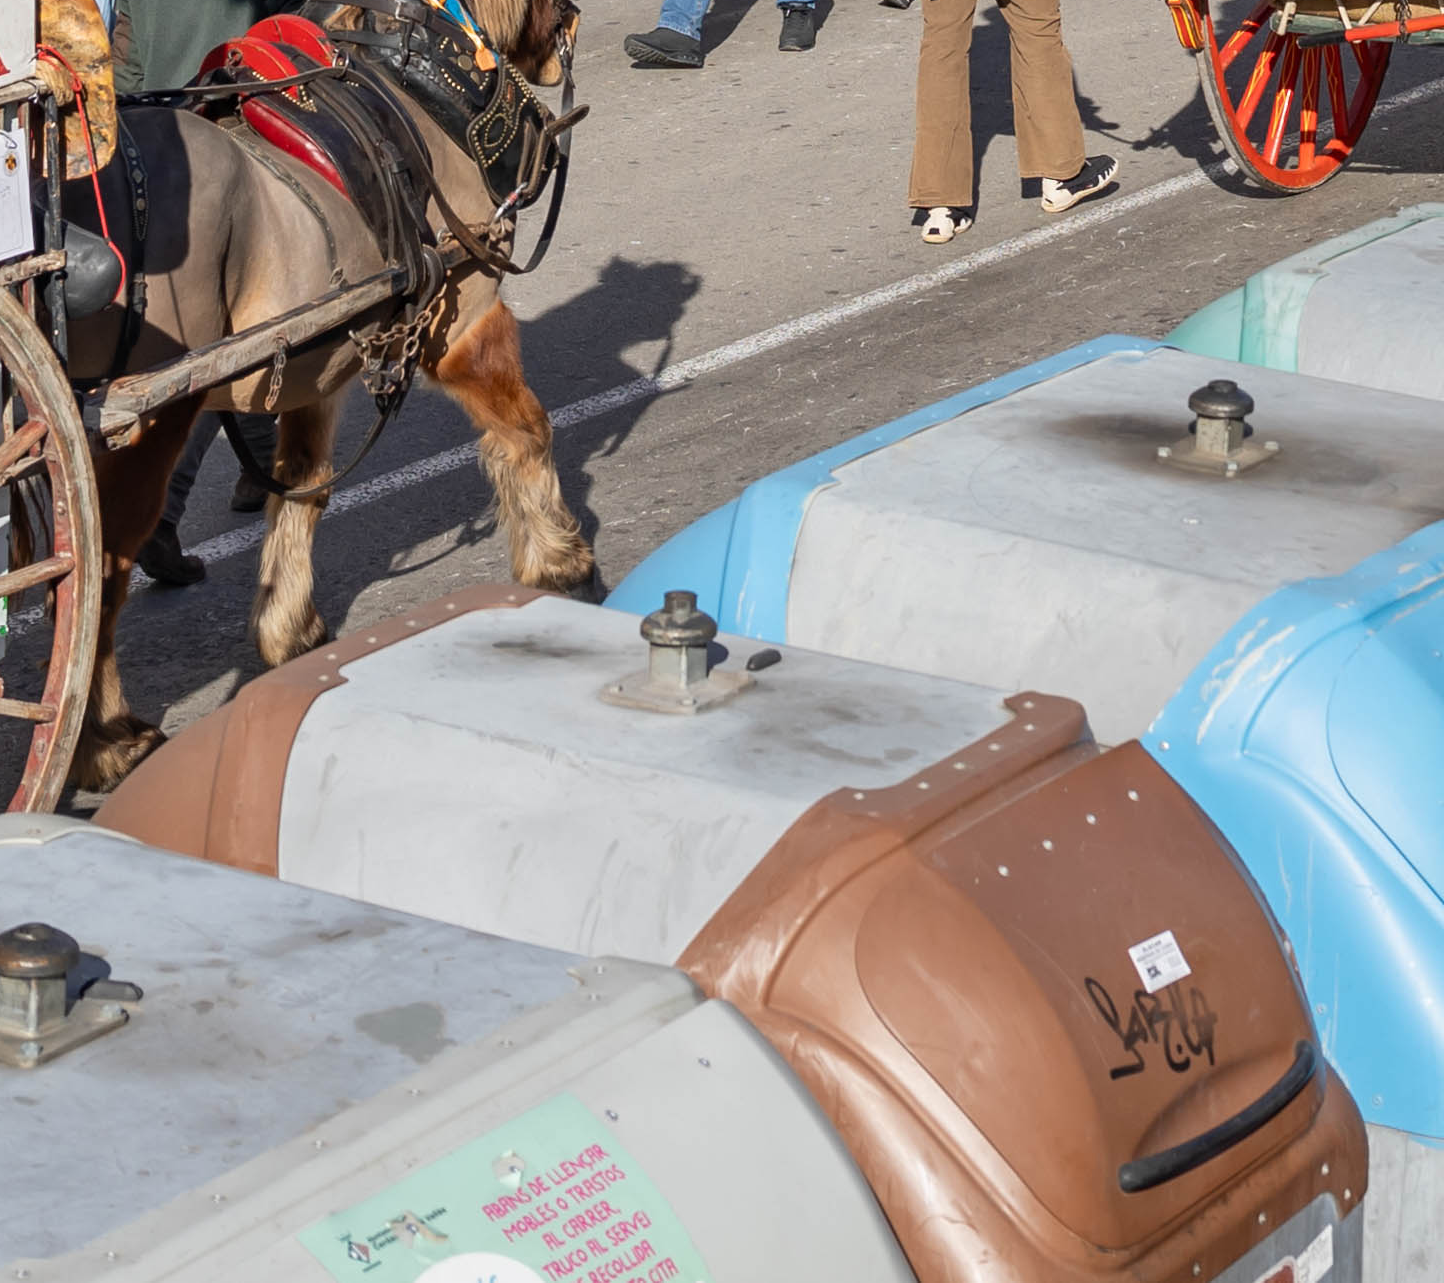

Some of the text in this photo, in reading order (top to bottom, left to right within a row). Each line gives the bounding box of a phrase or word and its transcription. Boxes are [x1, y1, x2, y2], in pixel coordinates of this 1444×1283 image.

[482, 1144, 610, 1221] ABANS DE LLENÇAR
[502, 1164, 626, 1243] MOBLES O TRASTOS
[542, 1231, 566, 1250] AL
[542, 1210, 652, 1281] TRUCO AL SERVEI
[587, 1239, 656, 1283] RECOLLIDA
[648, 1257, 679, 1282] CITA
